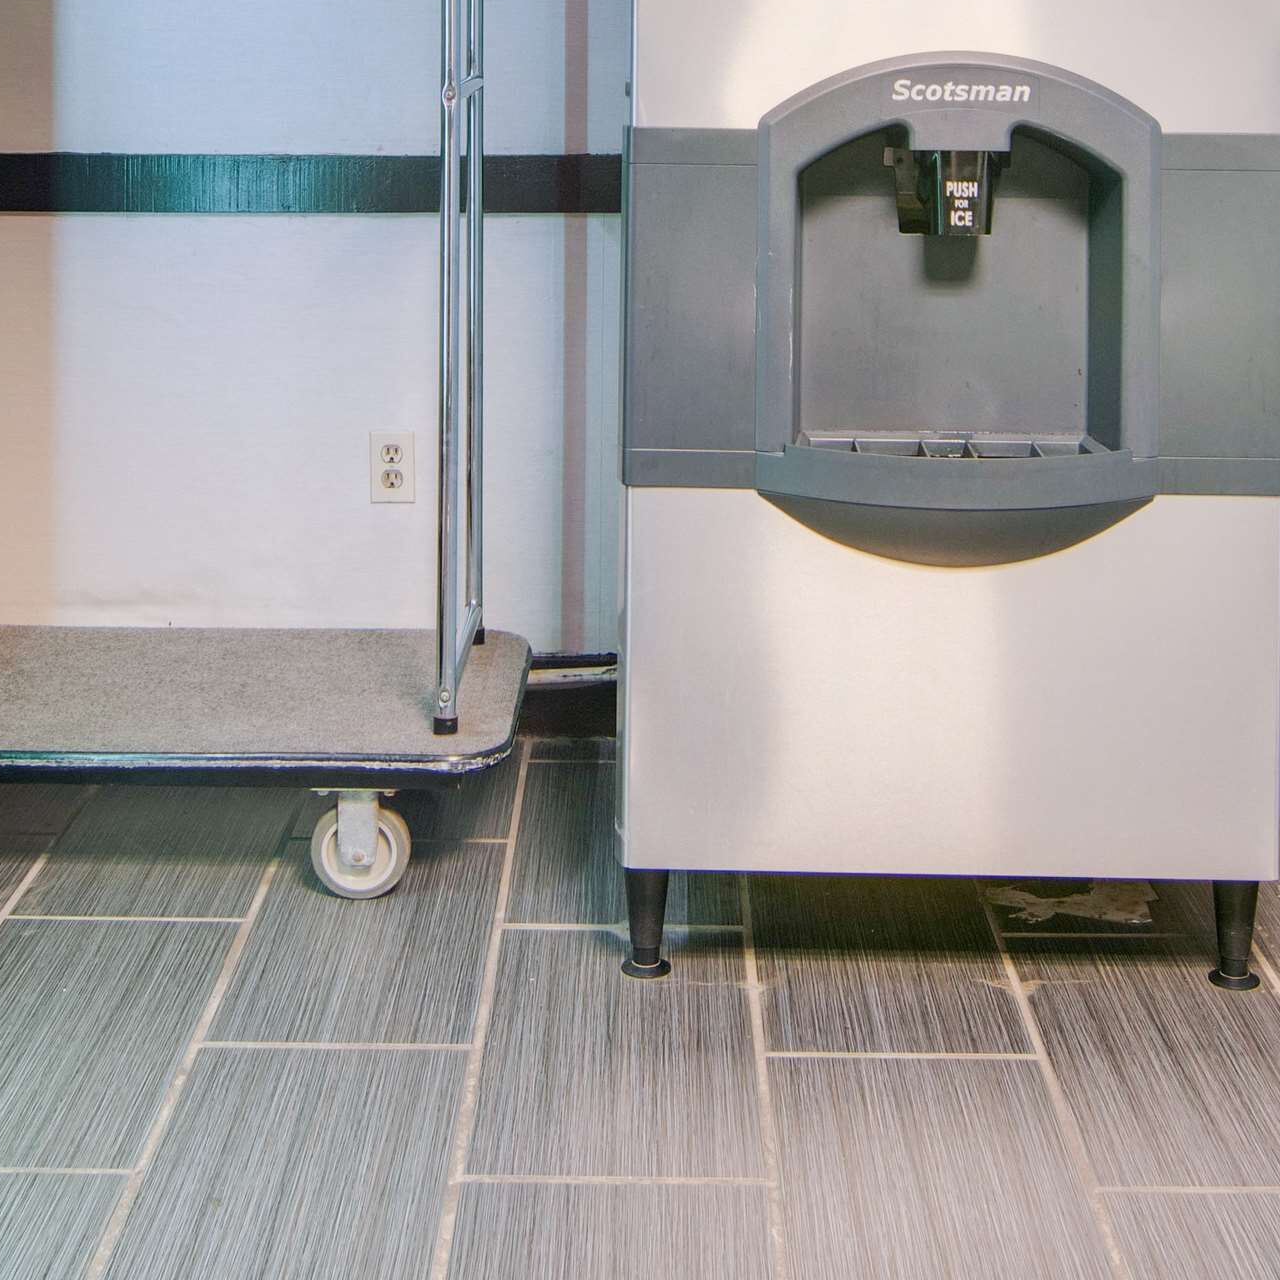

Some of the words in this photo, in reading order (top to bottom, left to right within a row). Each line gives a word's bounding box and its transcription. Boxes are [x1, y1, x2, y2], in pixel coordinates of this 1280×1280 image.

[891, 78, 1032, 103] Scotsman
[946, 180, 979, 198] PUSH
[954, 199, 969, 209] FOR
[950, 210, 974, 227] ICE
